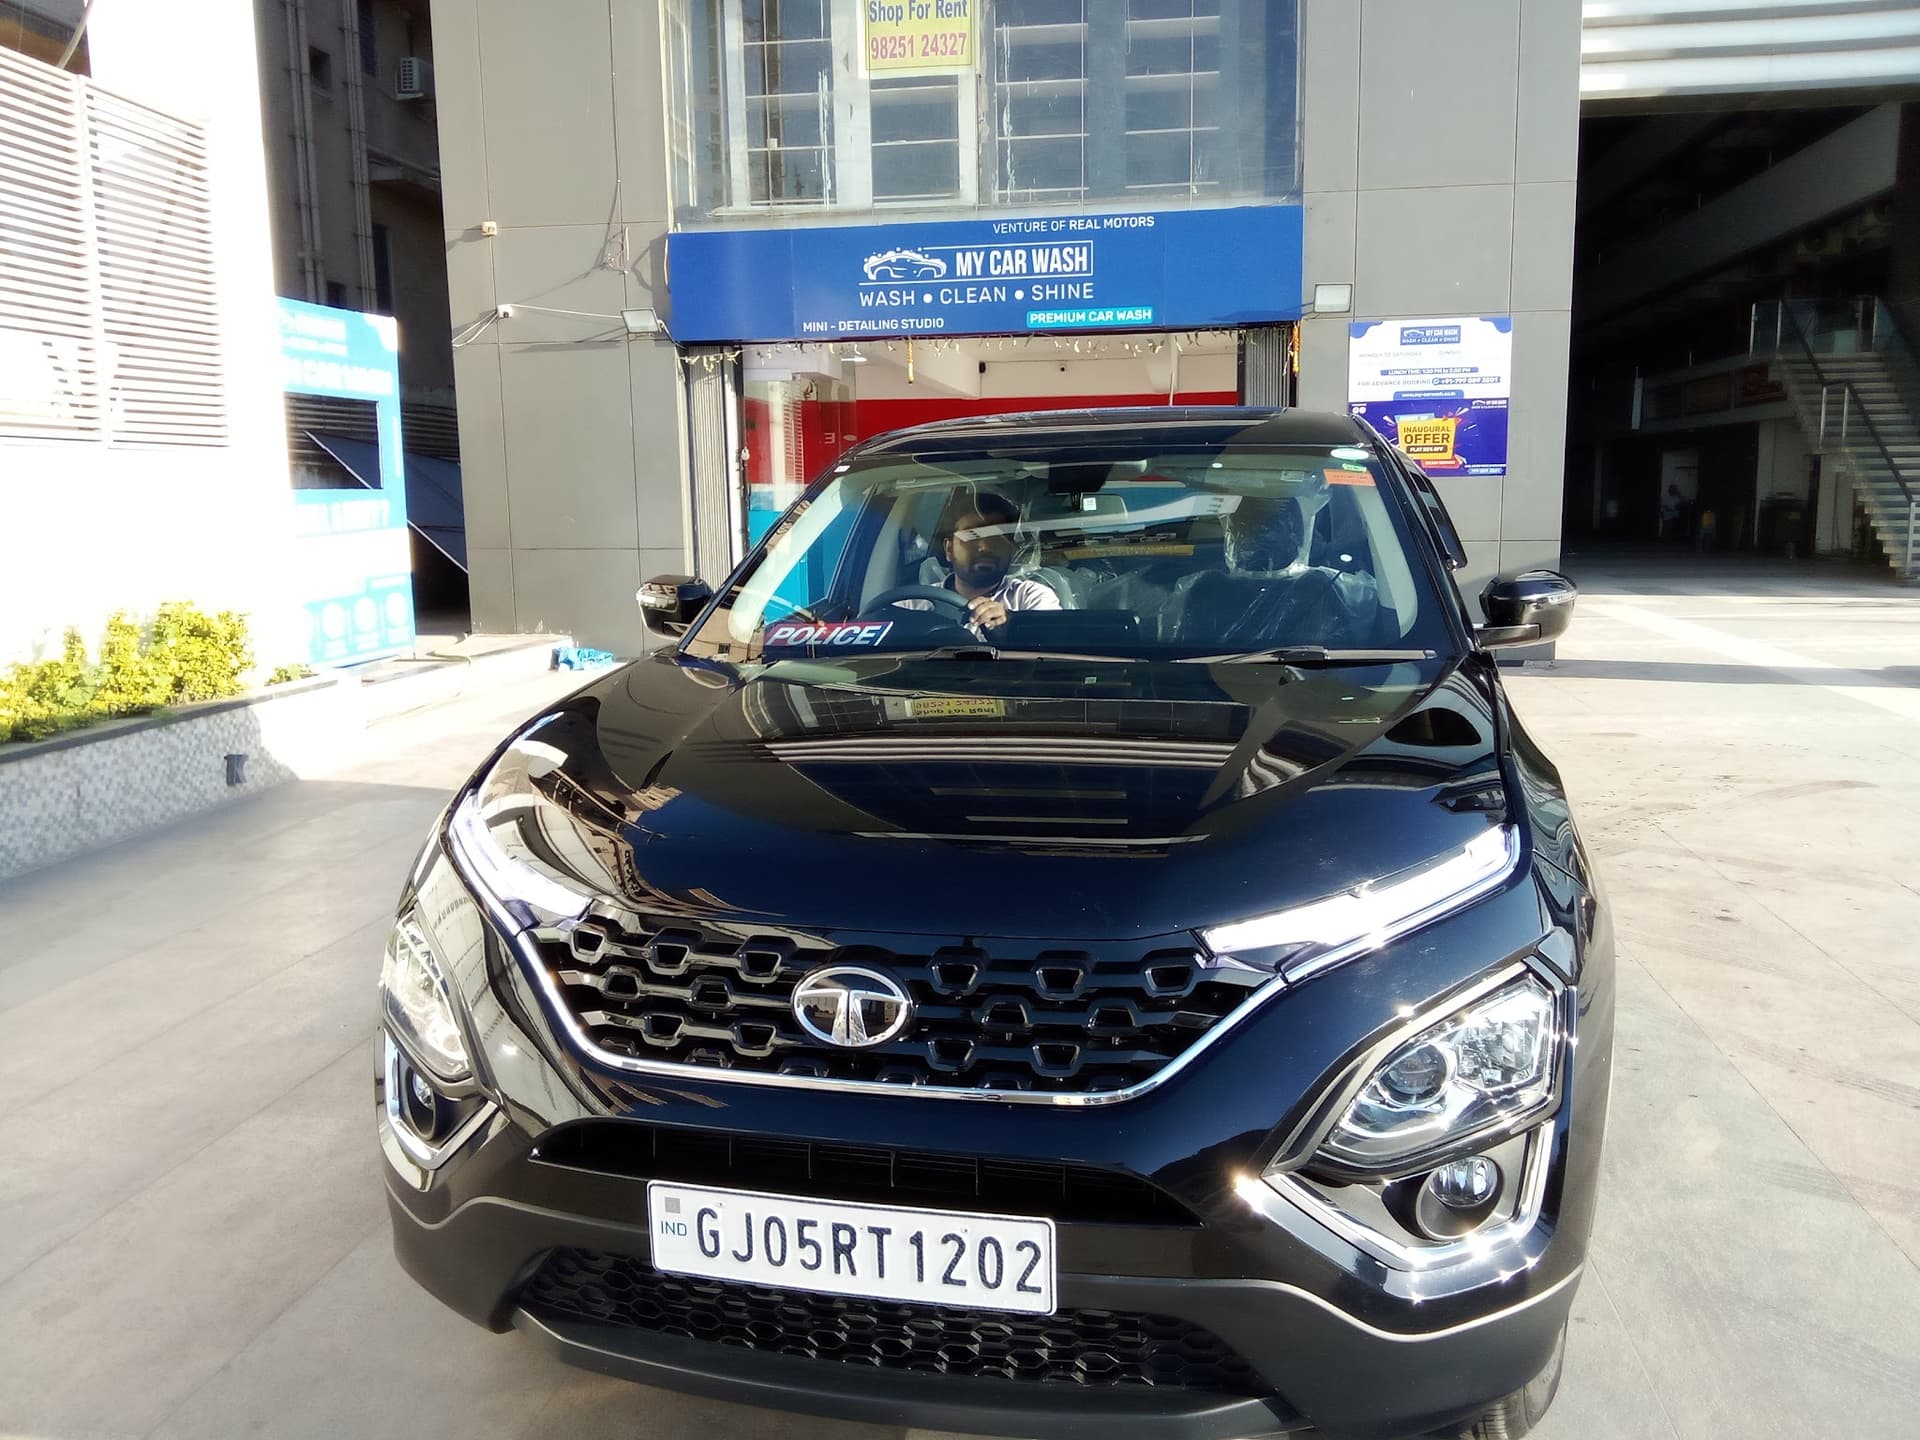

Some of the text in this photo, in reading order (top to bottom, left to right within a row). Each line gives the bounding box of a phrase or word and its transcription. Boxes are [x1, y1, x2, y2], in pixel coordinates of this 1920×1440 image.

[869, 0, 968, 27] Shop For Rent
[871, 32, 967, 60] 98251 24327
[993, 216, 1155, 234] VENTURE OF REAL MOTORS
[956, 246, 1088, 277] MY CAR WASH
[859, 282, 1094, 307] WASH CLEAN SHINE
[803, 321, 828, 332] MINI
[838, 319, 899, 332] DETAILING
[901, 317, 944, 329] STUDIO
[1029, 308, 1152, 325] PREMIUM CAR WASH
[1404, 433, 1450, 444] OFFER
[766, 625, 881, 645] POLICE
[660, 1220, 688, 1238] IND
[697, 1207, 1042, 1294] GJ05RT1202
